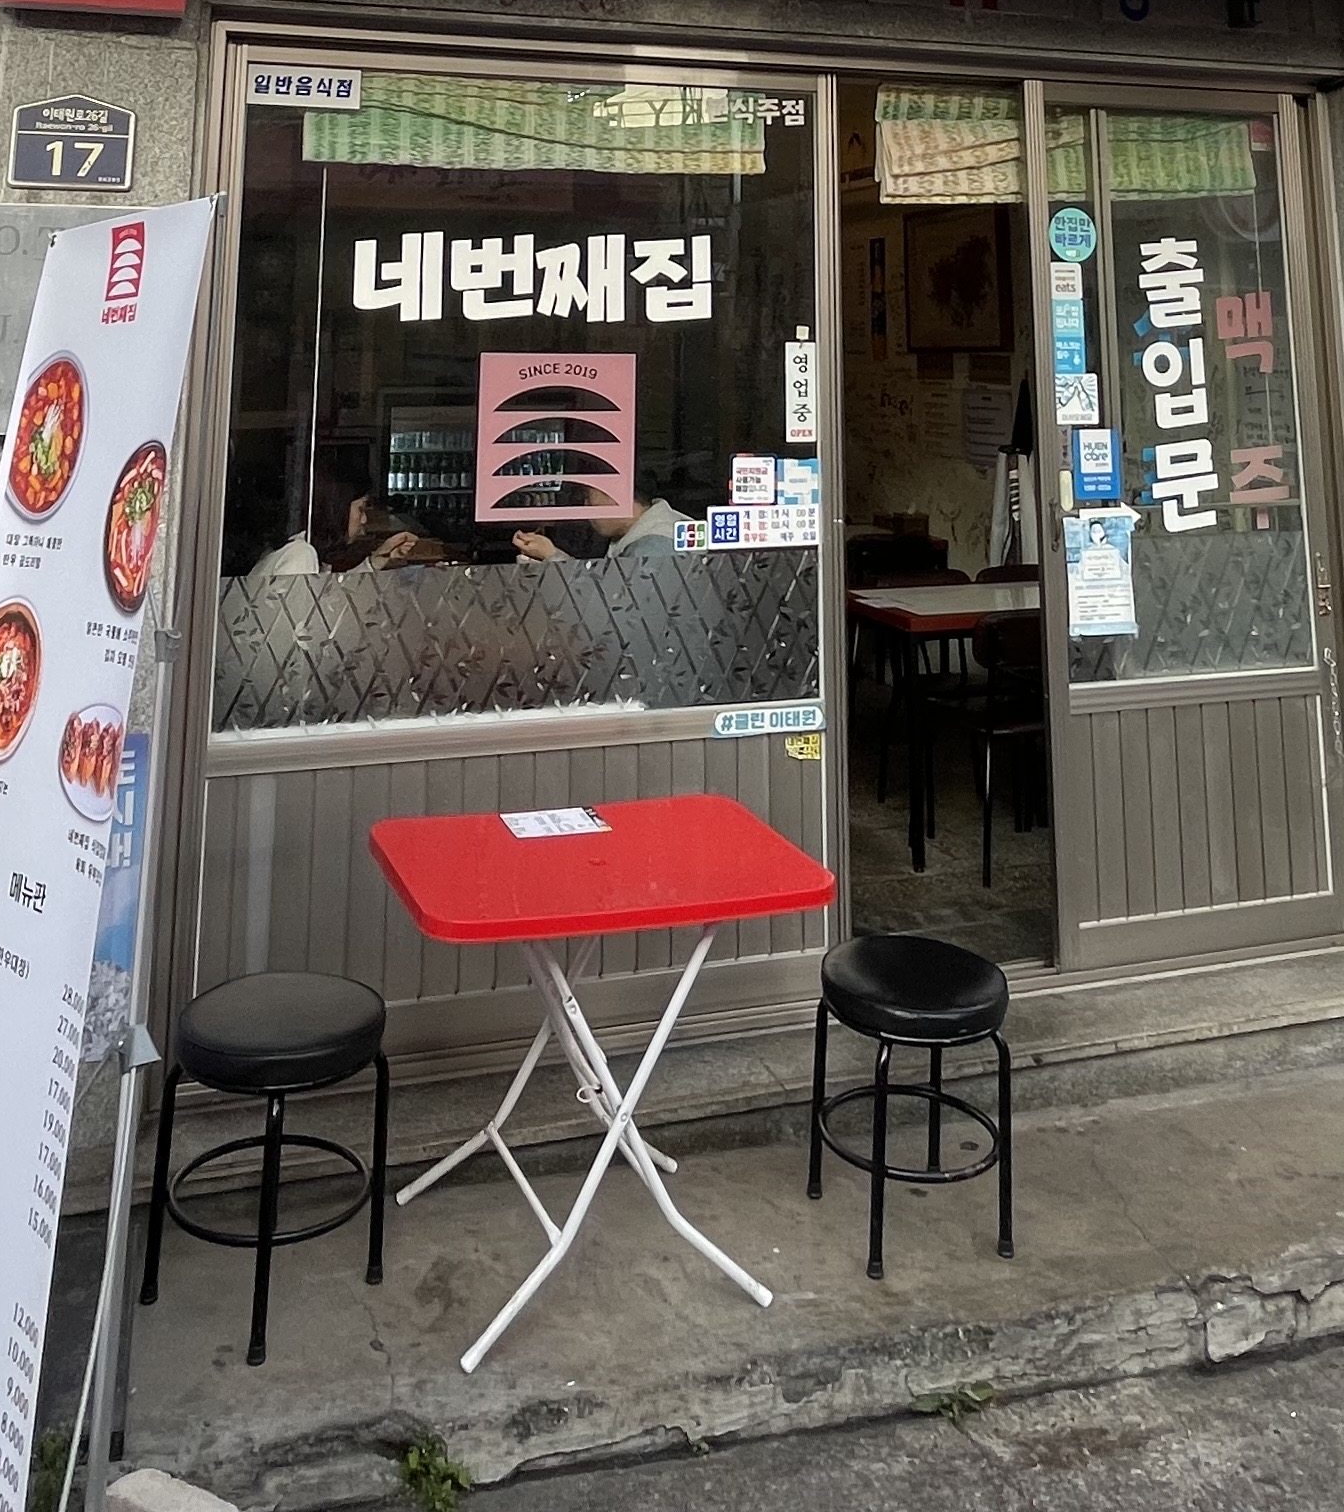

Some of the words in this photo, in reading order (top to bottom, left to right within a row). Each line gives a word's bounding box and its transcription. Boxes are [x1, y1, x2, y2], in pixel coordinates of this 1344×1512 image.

[253, 72, 355, 100] 일반음식점
[42, 106, 109, 124] 이태원로26길
[45, 140, 105, 178] 17
[352, 230, 714, 324] 네번째집
[518, 363, 561, 380] SINCE
[564, 363, 599, 380] 2019
[792, 353, 812, 422] 영업중
[1137, 236, 1219, 534] 출입문
[1216, 290, 1290, 531] 맥주
[790, 429, 813, 438] OPEN
[715, 514, 737, 528] 영업
[677, 527, 706, 546] JCB
[714, 528, 737, 541] 시간
[769, 709, 816, 728] 이태원
[9, 872, 47, 914] 메뉴판
